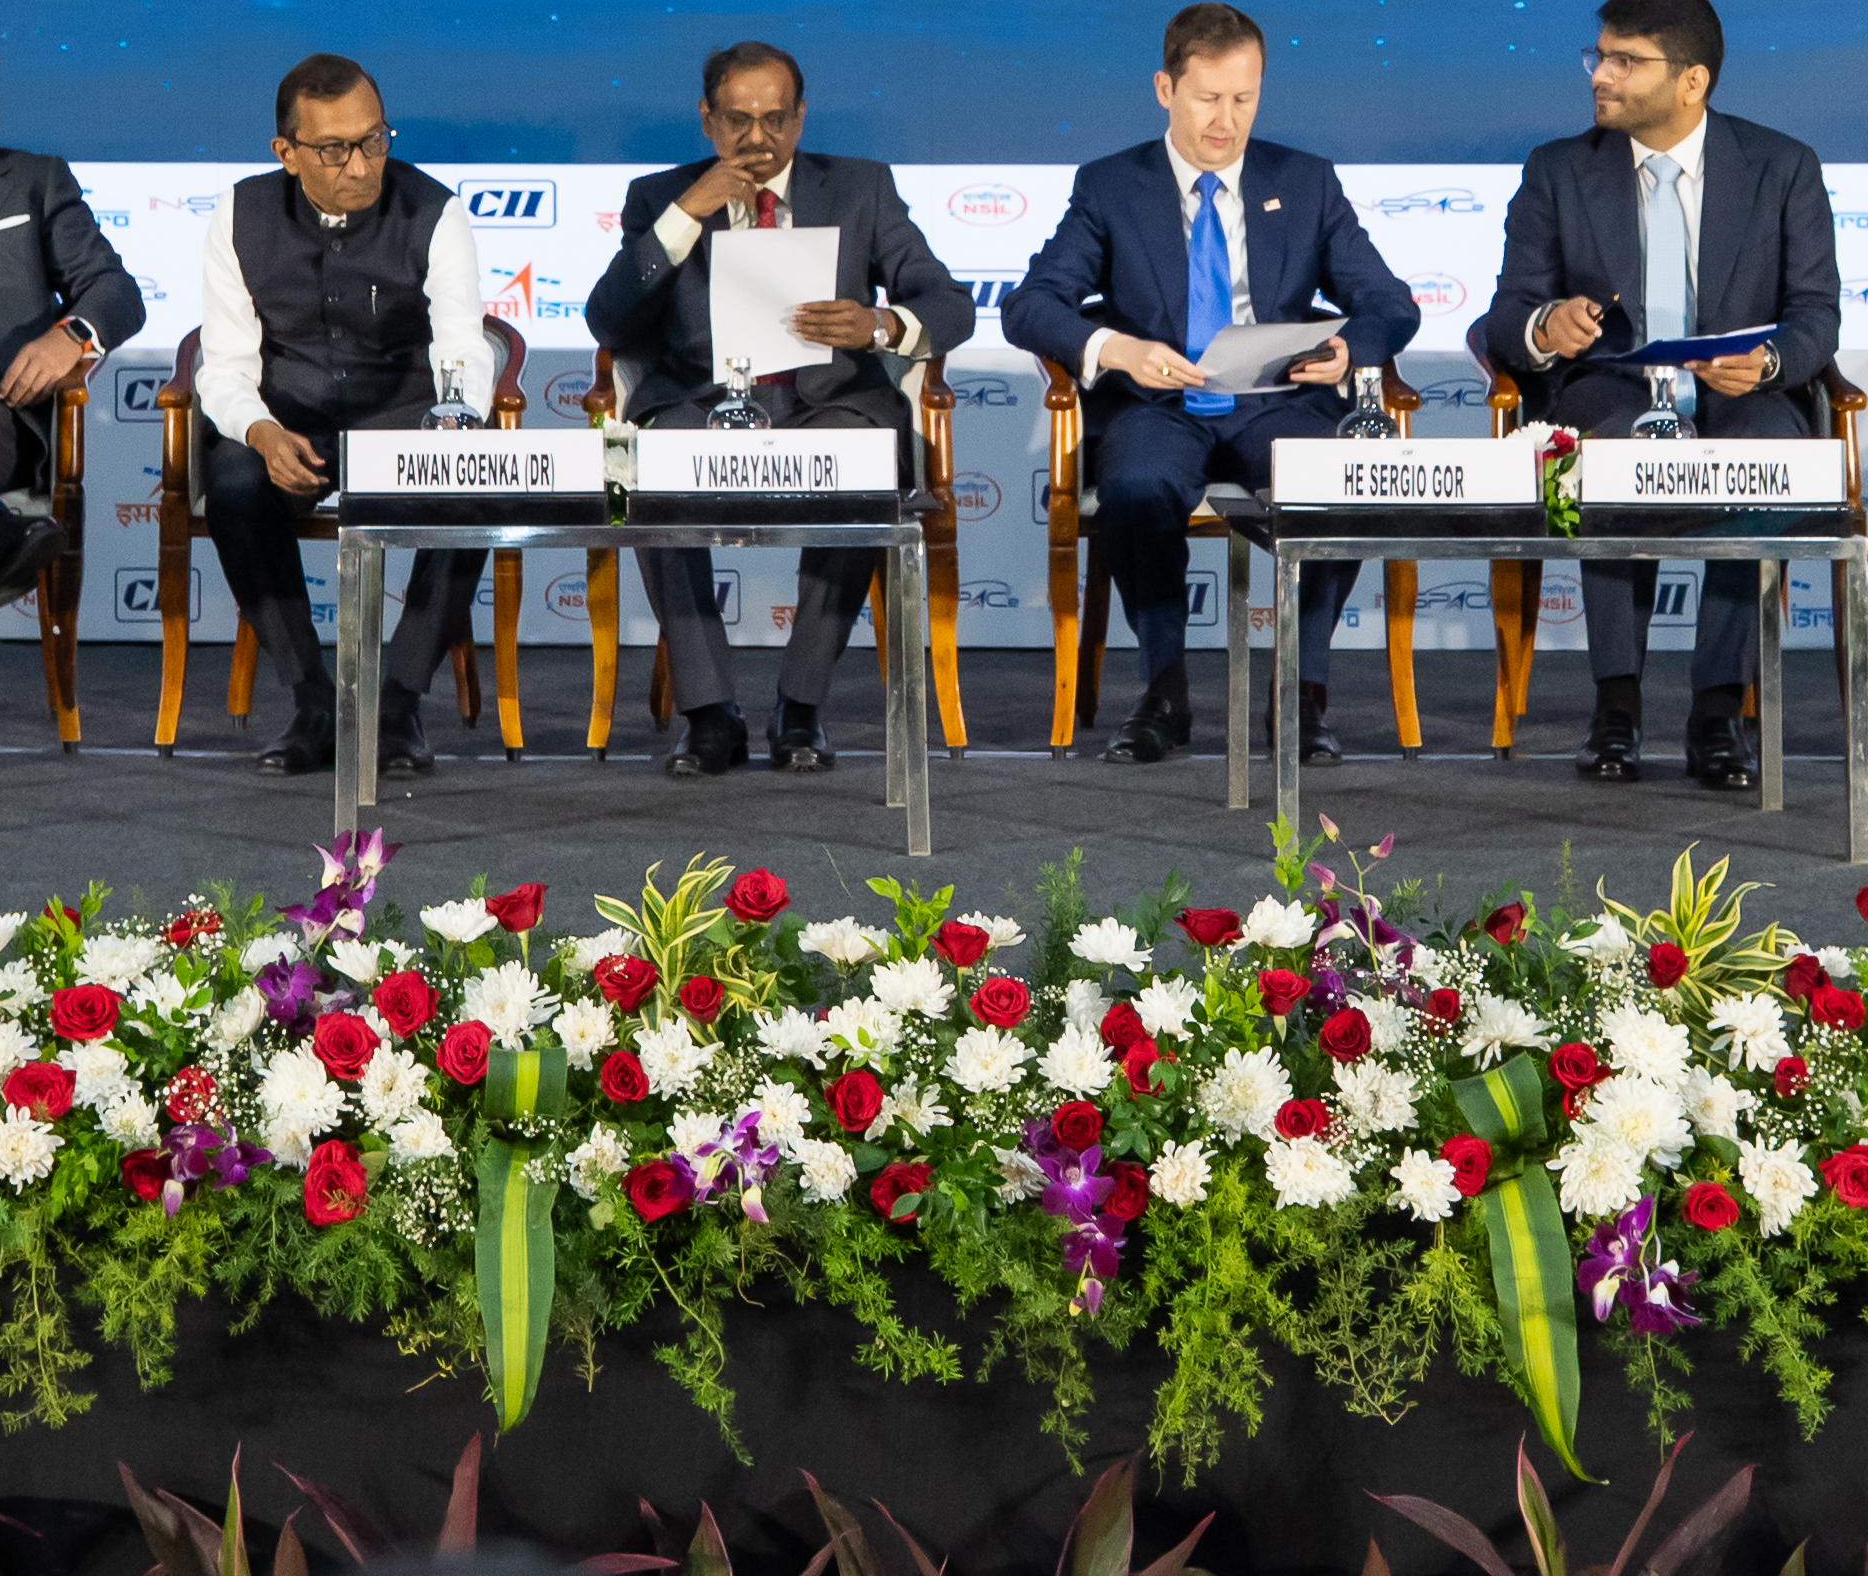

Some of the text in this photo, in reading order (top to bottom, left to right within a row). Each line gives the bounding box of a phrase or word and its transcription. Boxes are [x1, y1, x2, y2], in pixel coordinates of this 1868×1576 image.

[468, 190, 545, 218] CII
[397, 453, 555, 489] PAWAN GOENKA (DR)
[692, 454, 839, 491] V NARAYANAN (DR)
[1344, 463, 1464, 498] HE SERGIO GOR
[1635, 462, 1791, 496] SHASHWAT GOENKA
